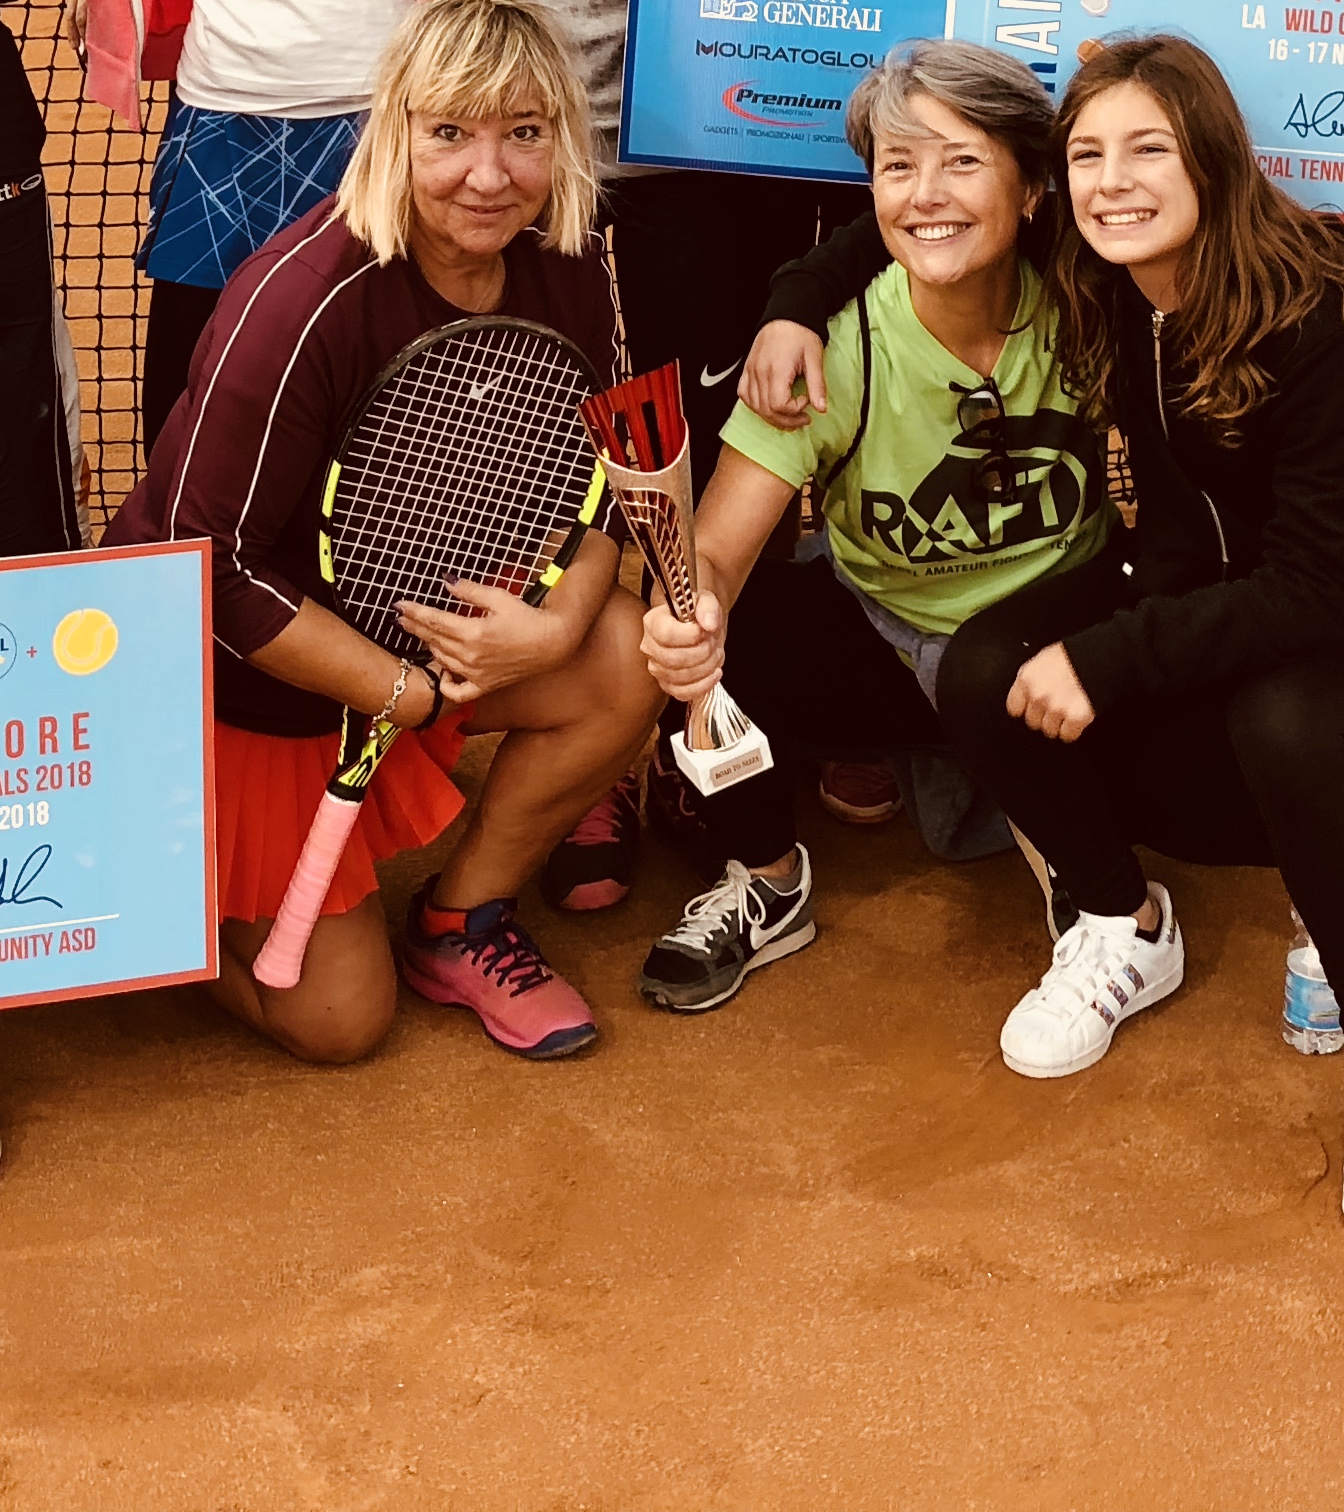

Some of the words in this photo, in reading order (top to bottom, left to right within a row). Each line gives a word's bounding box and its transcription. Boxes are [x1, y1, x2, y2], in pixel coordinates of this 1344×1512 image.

[763, 2, 882, 32] GENERALI
[1242, 4, 1266, 29] LA
[1285, 8, 1333, 34] WILD
[1268, 39, 1288, 61] 16
[1307, 41, 1328, 63] 17
[736, 88, 842, 110] Premium
[703, 125, 738, 136] GADGETS
[1258, 155, 1294, 178] CIAL
[861, 464, 1059, 556] RAFT
[925, 562, 988, 576] AMATEUR
[36, 760, 92, 791] 2018
[0, 801, 49, 830] 2018
[58, 926, 96, 953] ASD
